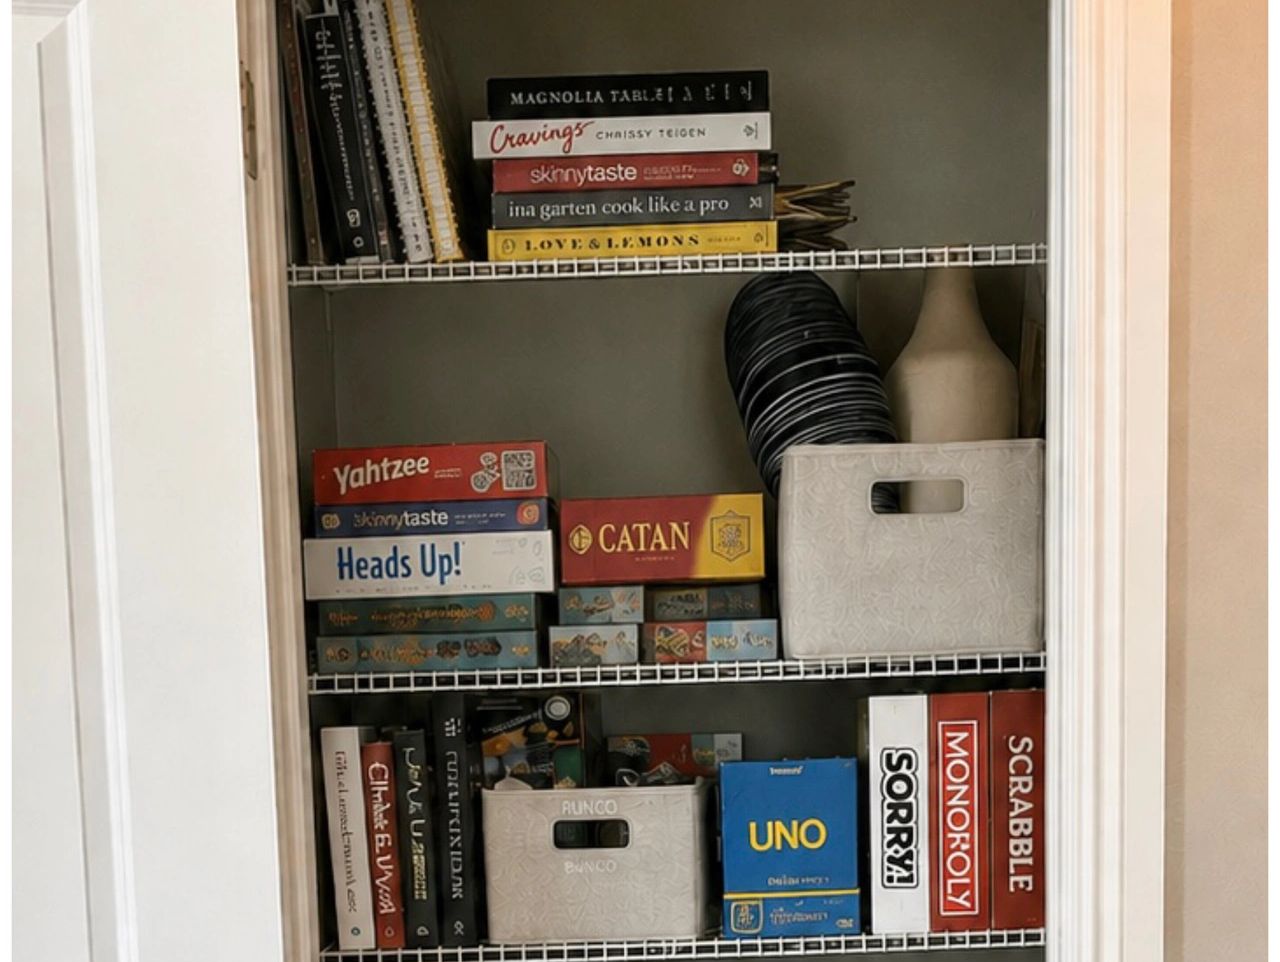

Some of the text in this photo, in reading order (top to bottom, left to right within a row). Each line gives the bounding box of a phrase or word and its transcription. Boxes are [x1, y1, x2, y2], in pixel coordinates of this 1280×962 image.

[490, 121, 595, 154] Cravings
[530, 162, 637, 187] skinnytaste
[509, 197, 729, 221] ina garten cook like a pro
[525, 237, 583, 251] LOVE
[606, 233, 700, 249] LEMONS
[333, 456, 430, 496] Yahtzee
[598, 521, 691, 555] CATAN
[337, 541, 462, 586] Heads Up!
[882, 747, 919, 889] SORRY!
[1008, 734, 1034, 893] SCRABBLE
[748, 817, 828, 852] UNO
